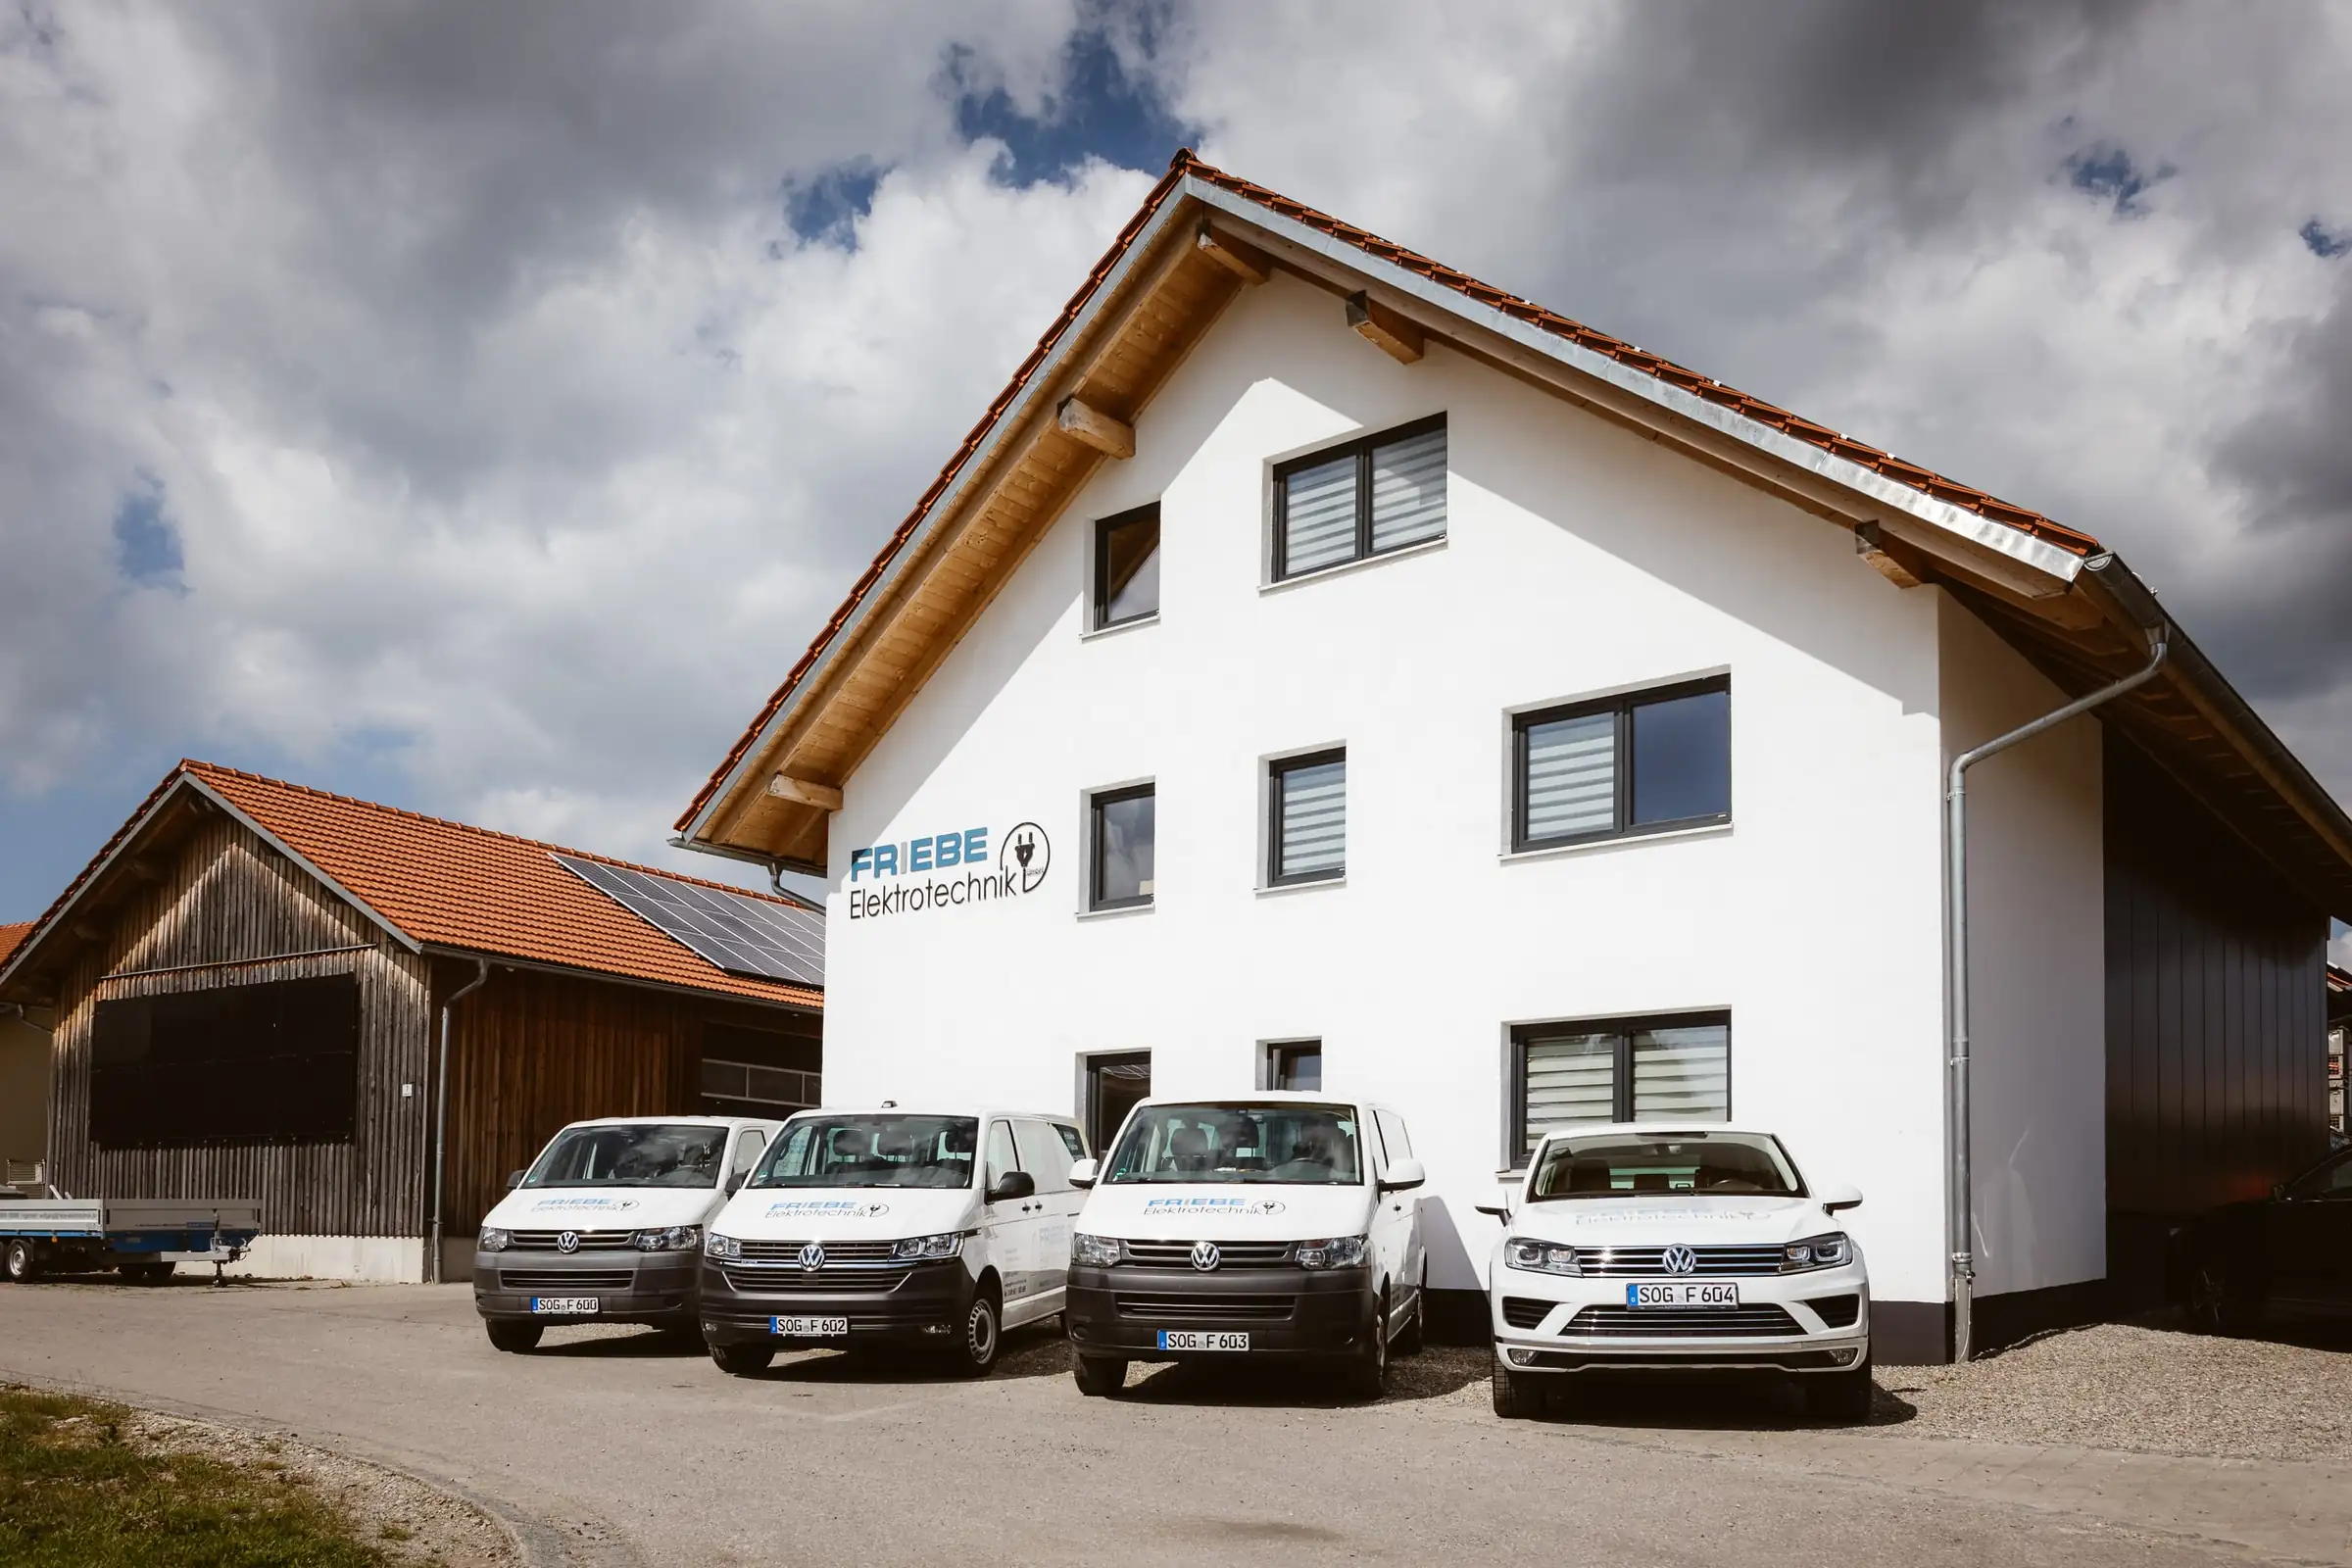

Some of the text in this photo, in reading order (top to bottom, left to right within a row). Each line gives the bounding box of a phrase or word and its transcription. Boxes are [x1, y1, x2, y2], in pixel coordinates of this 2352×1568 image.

[851, 827, 988, 882] FRIEBE
[850, 864, 1017, 919] Elektrotechnik
[770, 1201, 858, 1211] FRIEBE
[1148, 1199, 1247, 1207] FRIEBE
[764, 1208, 867, 1219] Elektrotechnik
[1143, 1206, 1263, 1216] Elektrotechnik
[1639, 1287, 1674, 1303] SOG
[1686, 1287, 1696, 1303] F
[1701, 1287, 1735, 1303] 604
[539, 1298, 597, 1310] SOG F 600
[777, 1319, 847, 1333] SOG F 602
[1168, 1334, 1248, 1349] SOG F 603
